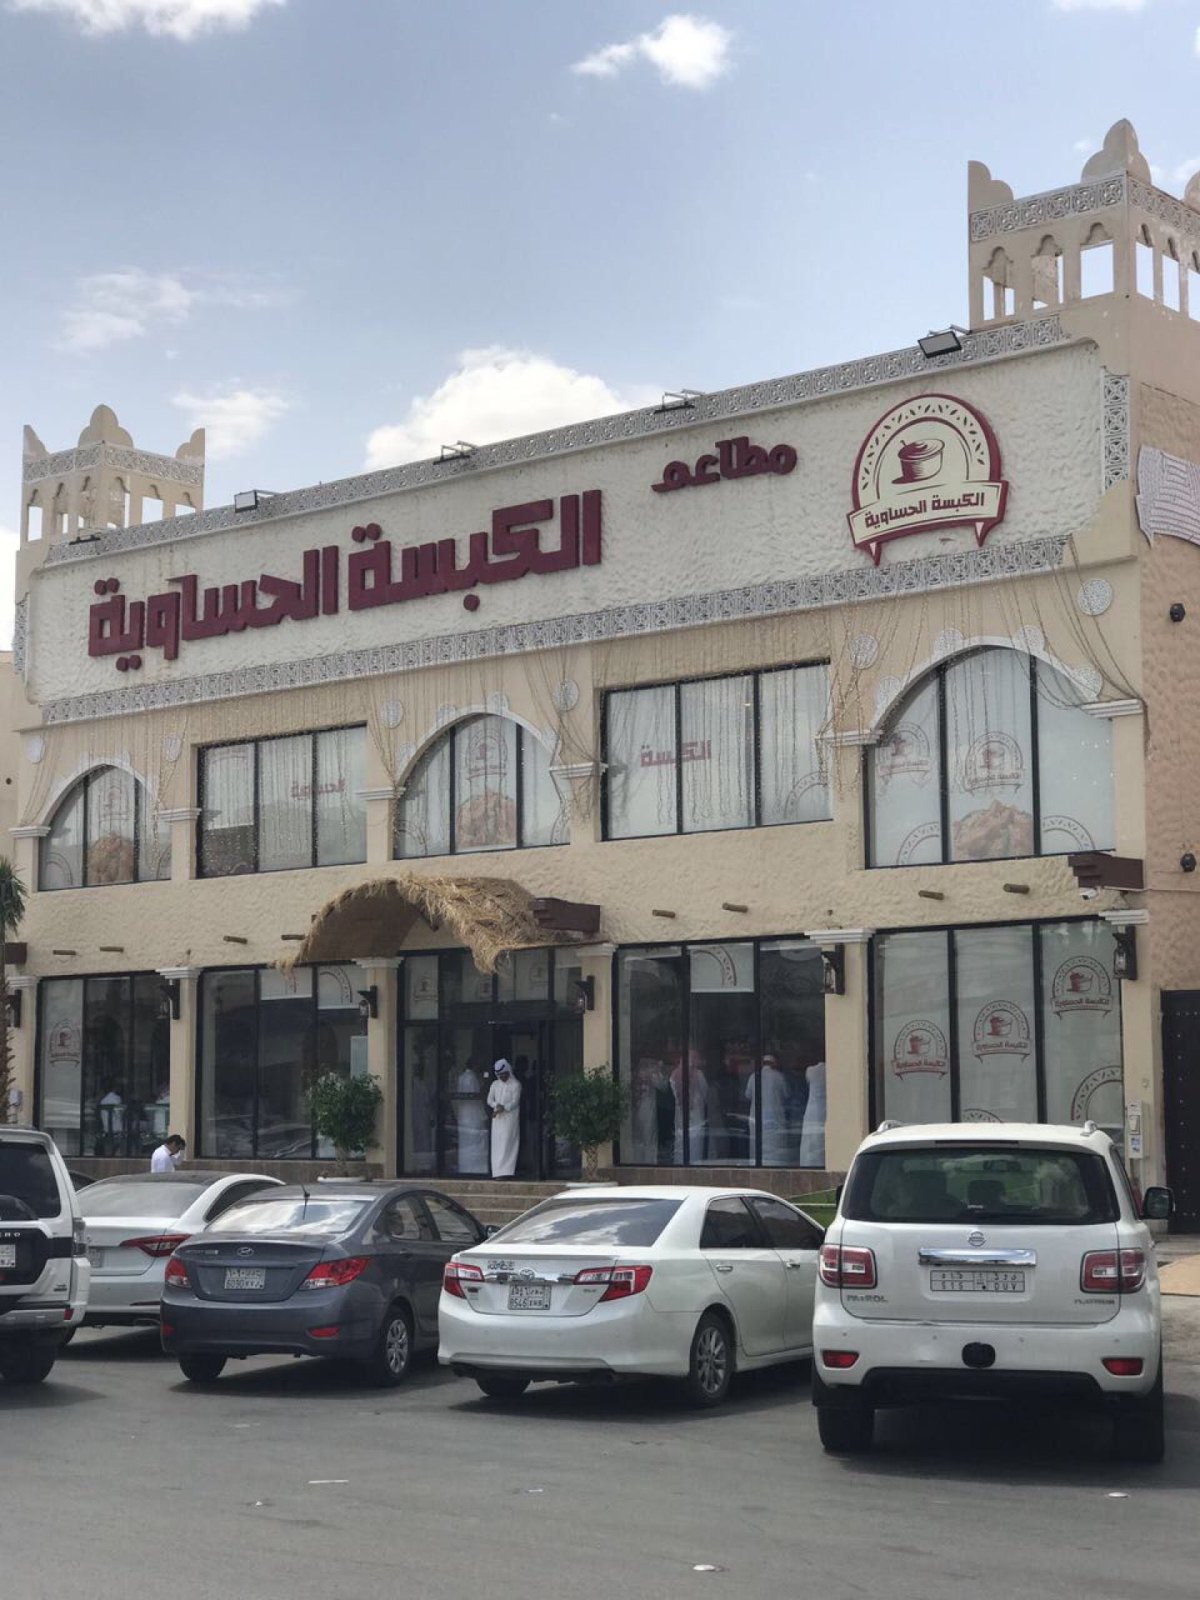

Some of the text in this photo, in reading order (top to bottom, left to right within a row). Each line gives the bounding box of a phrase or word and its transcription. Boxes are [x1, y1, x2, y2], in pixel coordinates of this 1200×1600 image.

[864, 492, 985, 529] الكبسة الحساوية
[88, 436, 798, 673] مطاعم الكبسة الحساوية
[640, 739, 713, 767] الكسة
